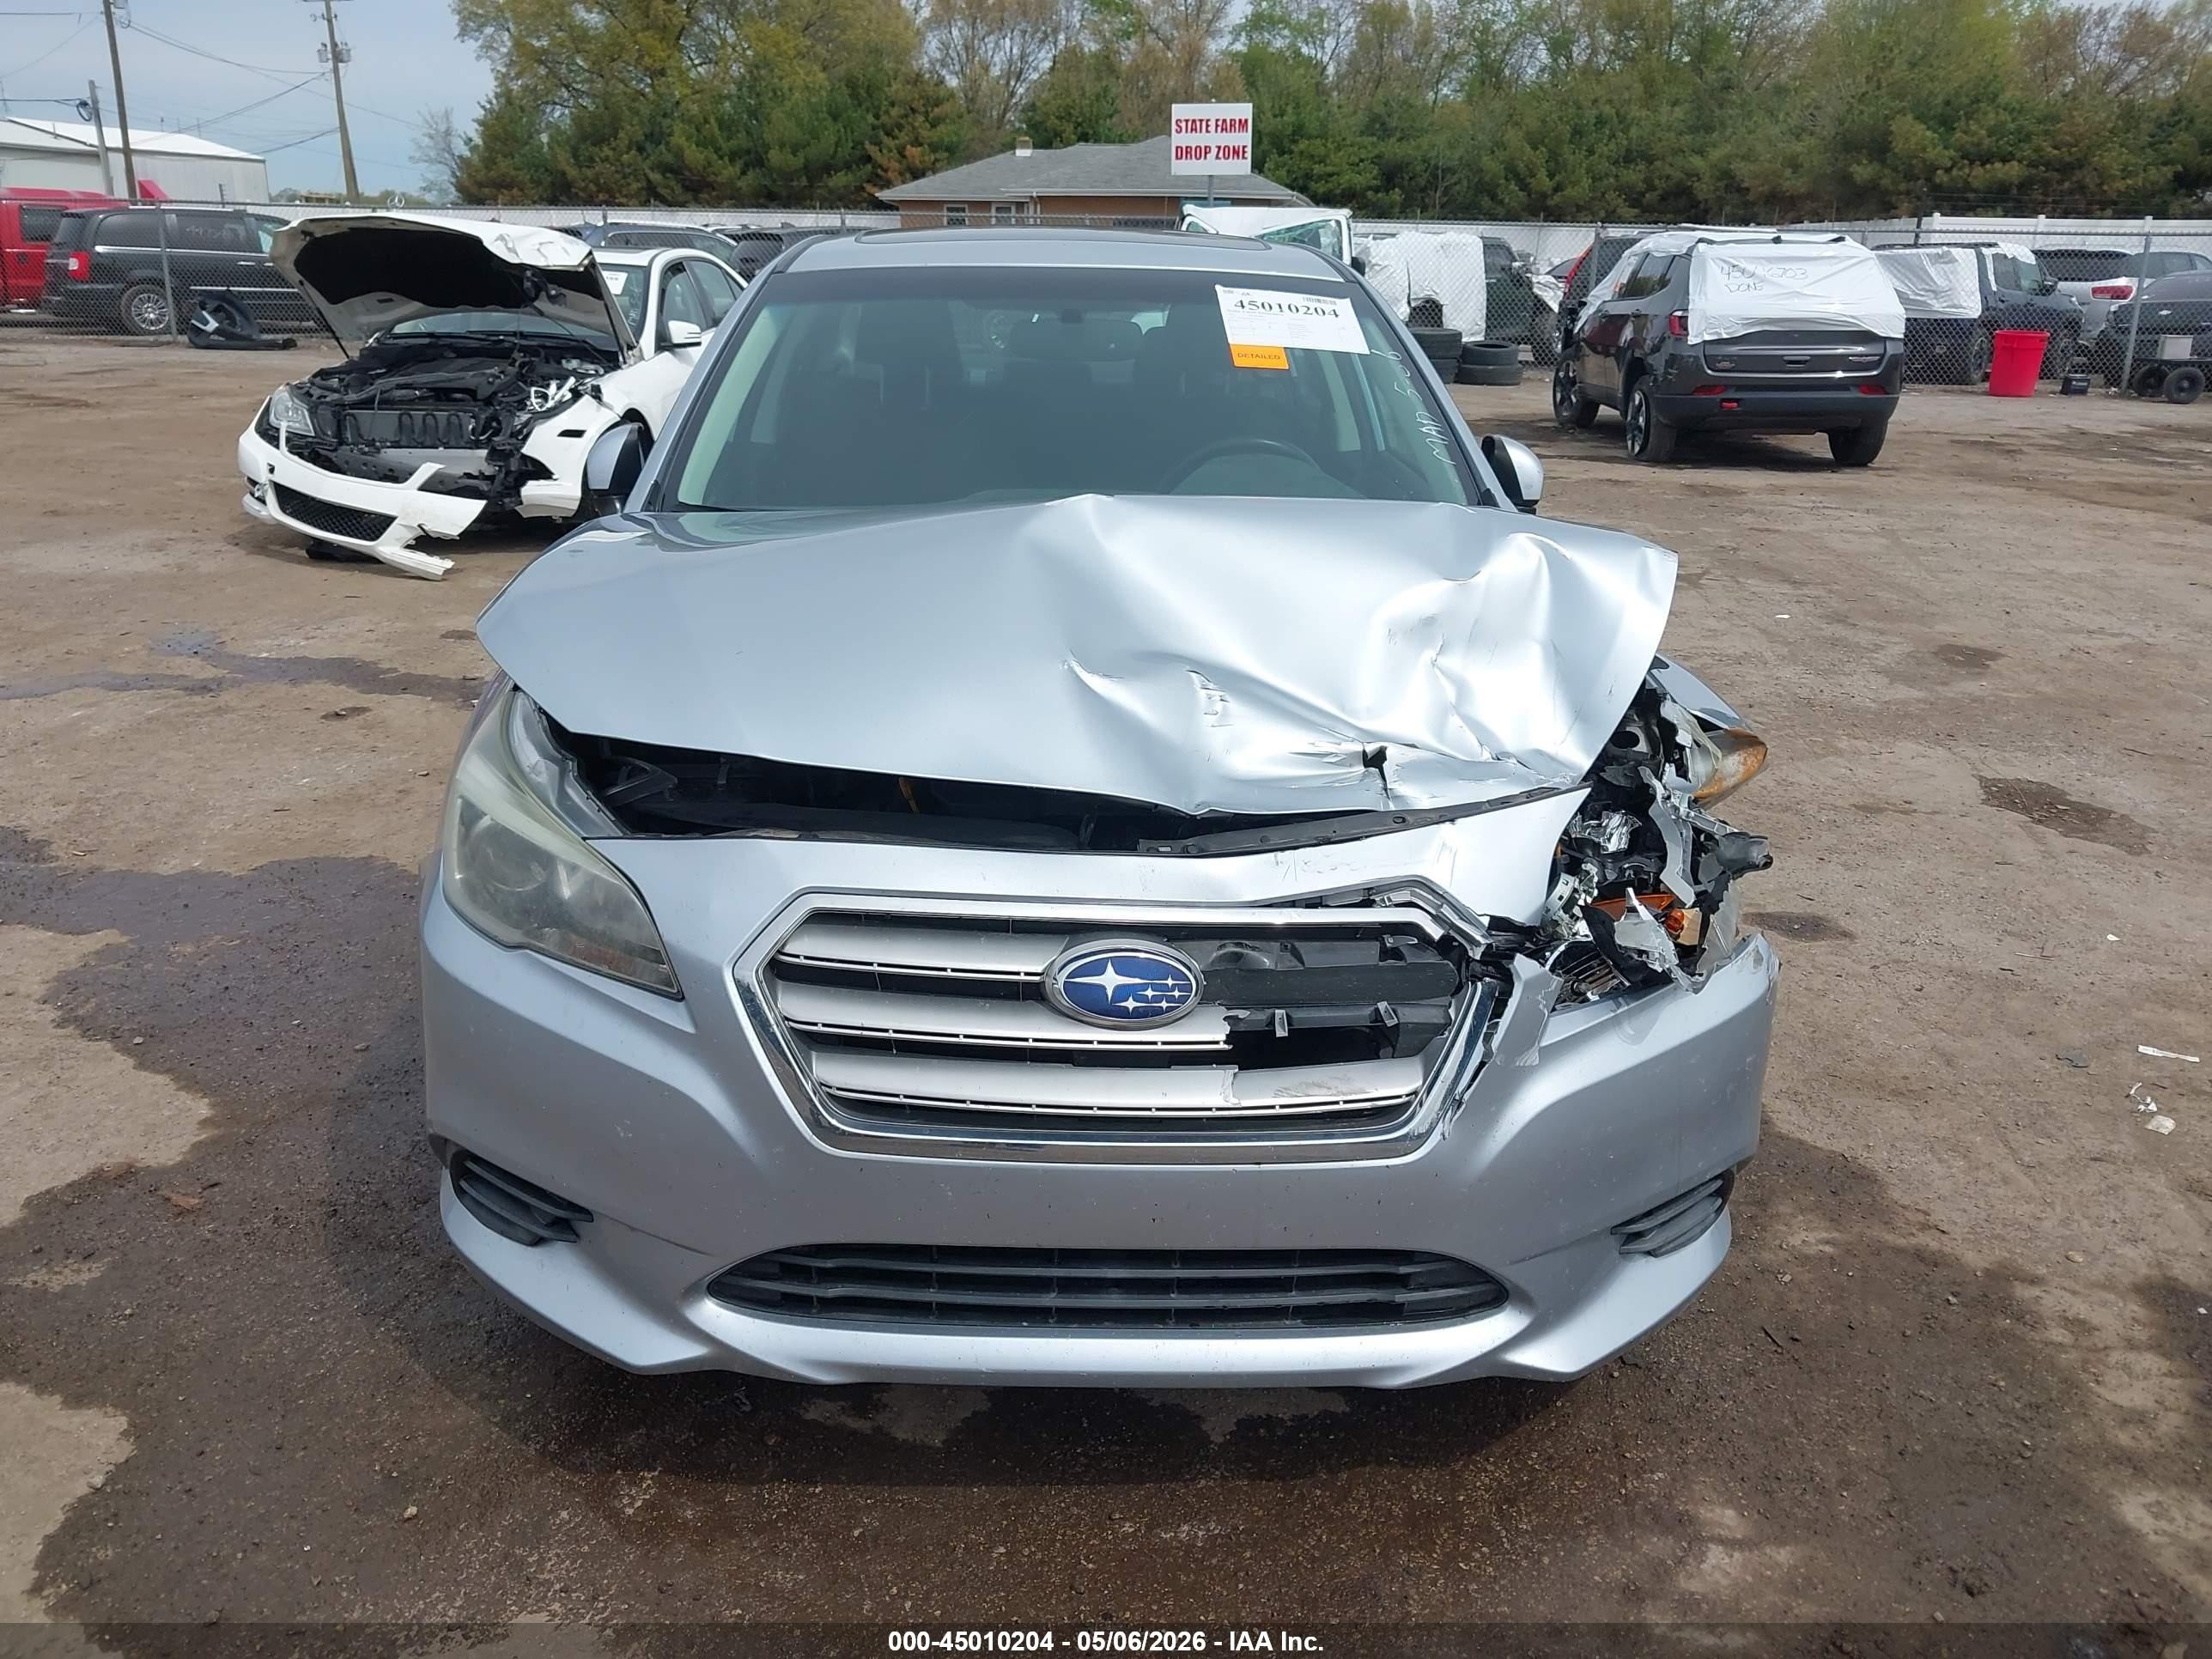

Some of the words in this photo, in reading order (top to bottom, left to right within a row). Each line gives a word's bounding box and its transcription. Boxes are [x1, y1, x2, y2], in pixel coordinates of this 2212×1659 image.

[1175, 118, 1212, 134] STATE
[1214, 118, 1249, 134] FARM
[1175, 145, 1212, 161] DROP
[1214, 144, 1249, 161] ZONE
[1234, 299, 1340, 319] 45010204
[1237, 352, 1281, 361] DETAILED
